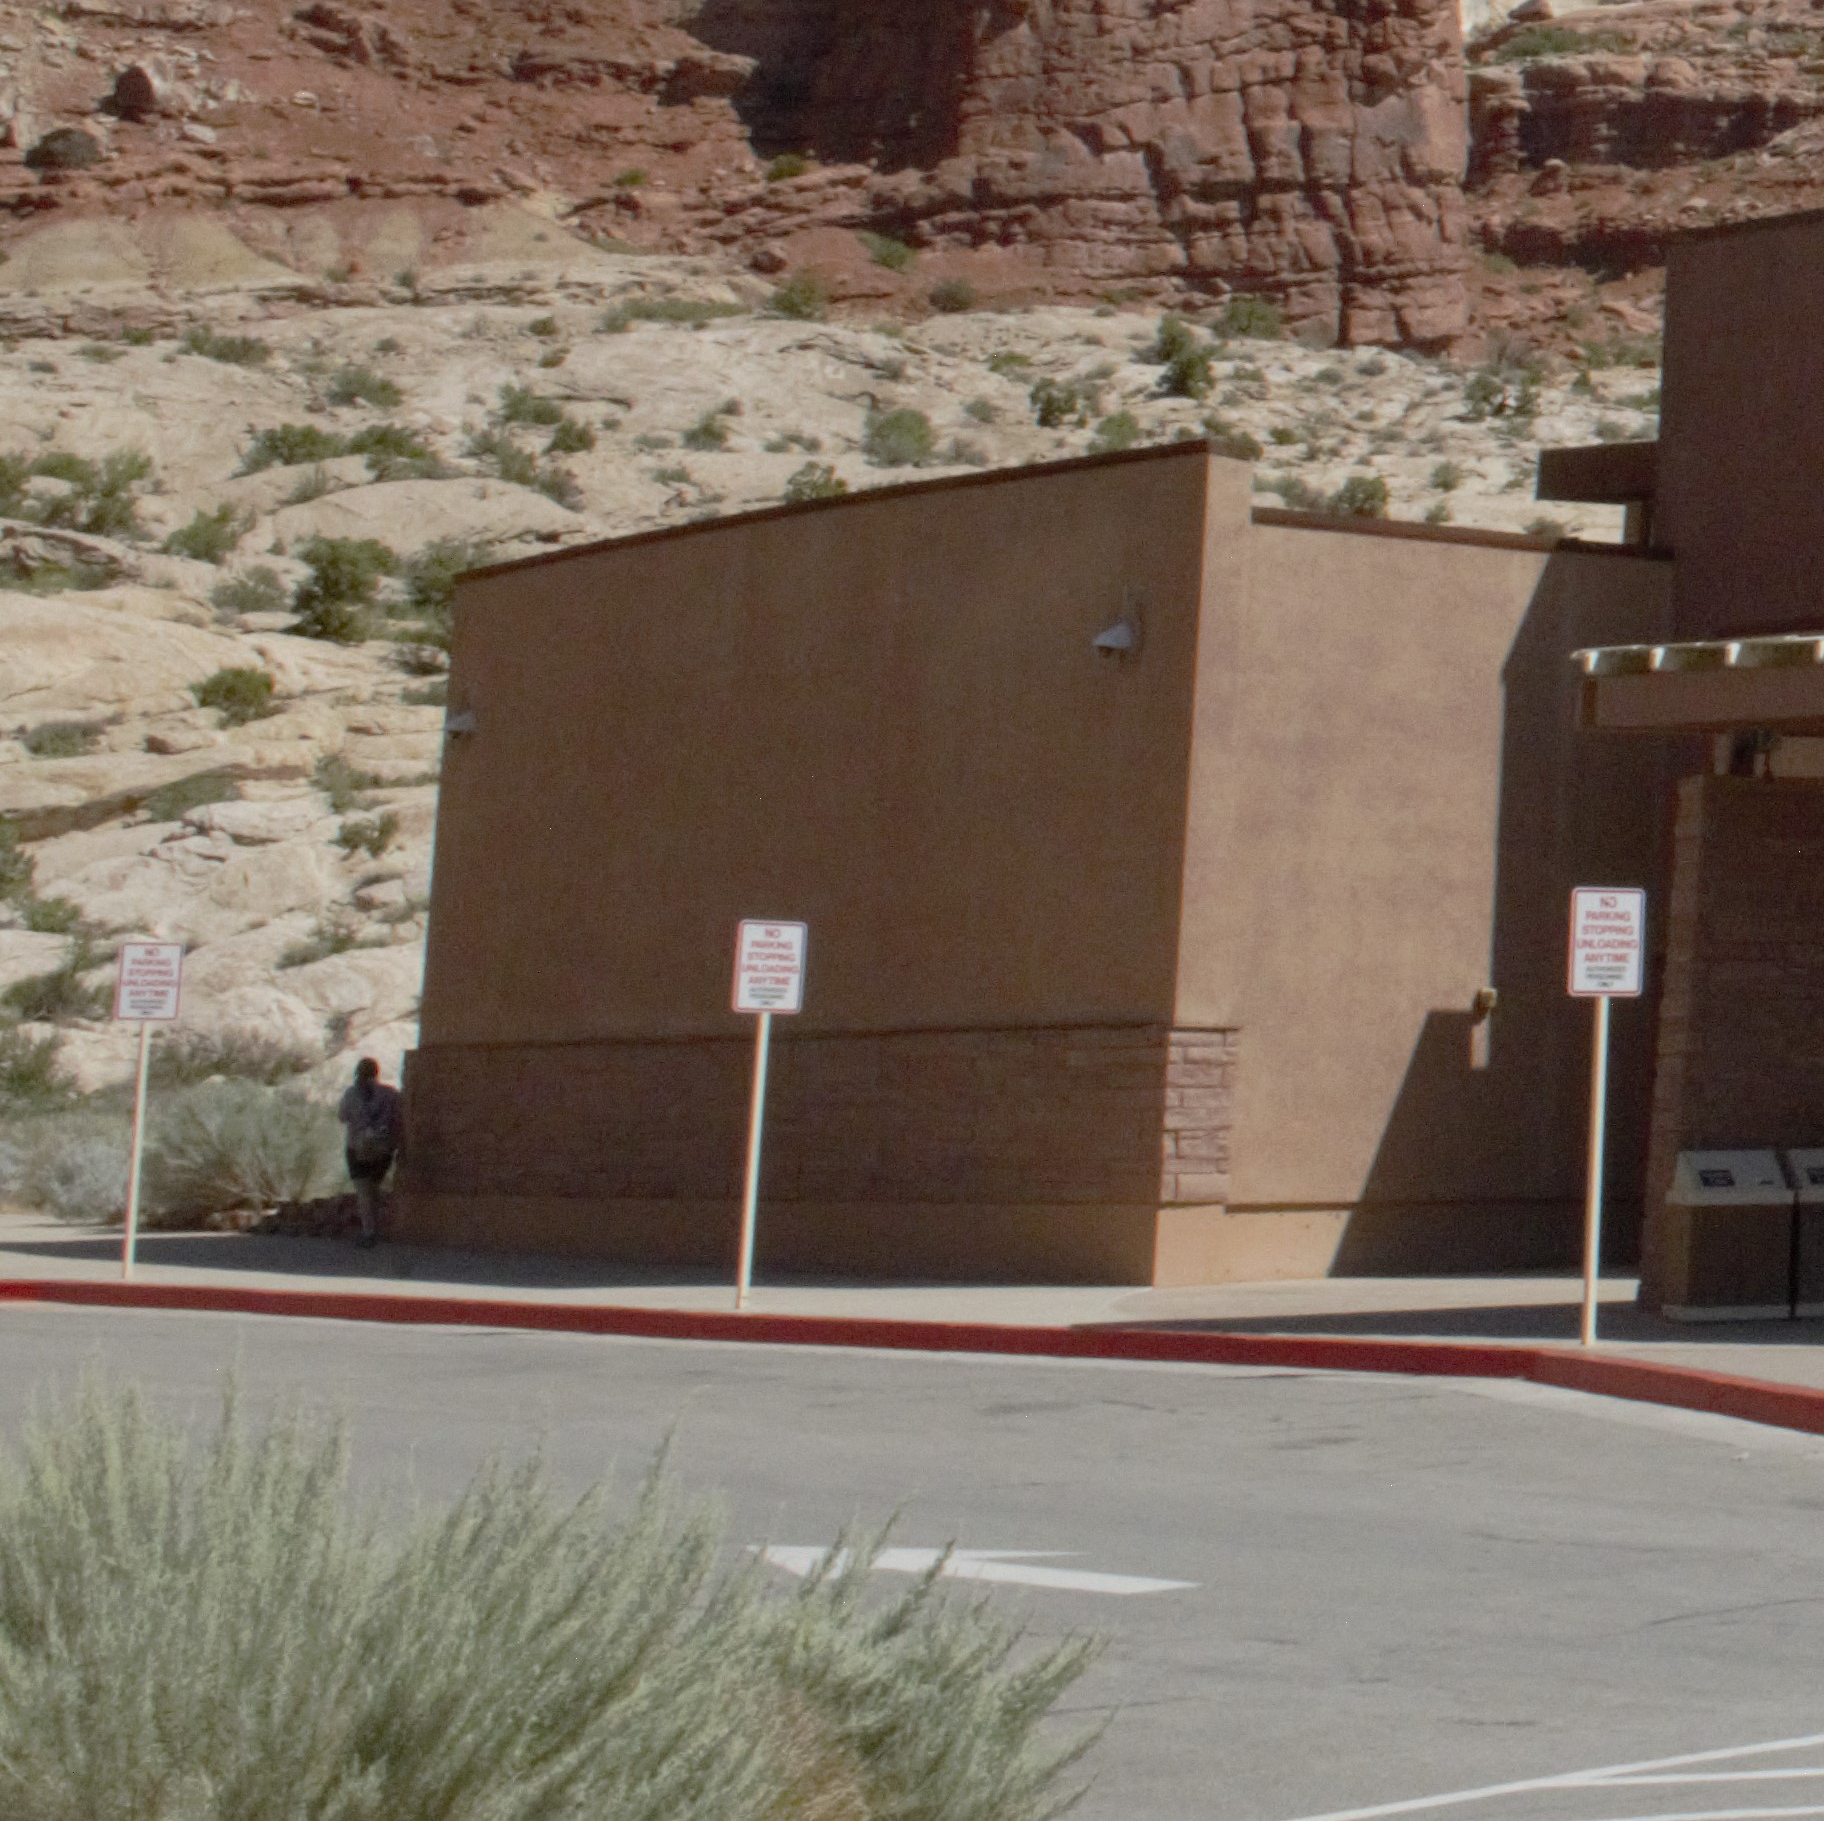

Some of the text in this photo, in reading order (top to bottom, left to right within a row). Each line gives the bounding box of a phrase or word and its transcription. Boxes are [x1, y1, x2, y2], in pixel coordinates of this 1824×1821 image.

[1600, 896, 1618, 908] NO
[1585, 910, 1631, 922] PARKING
[765, 928, 782, 938] NO
[1582, 924, 1634, 936] STOPPING
[1576, 939, 1638, 950] UNLOADING
[1584, 952, 1629, 963] ANYTIME
